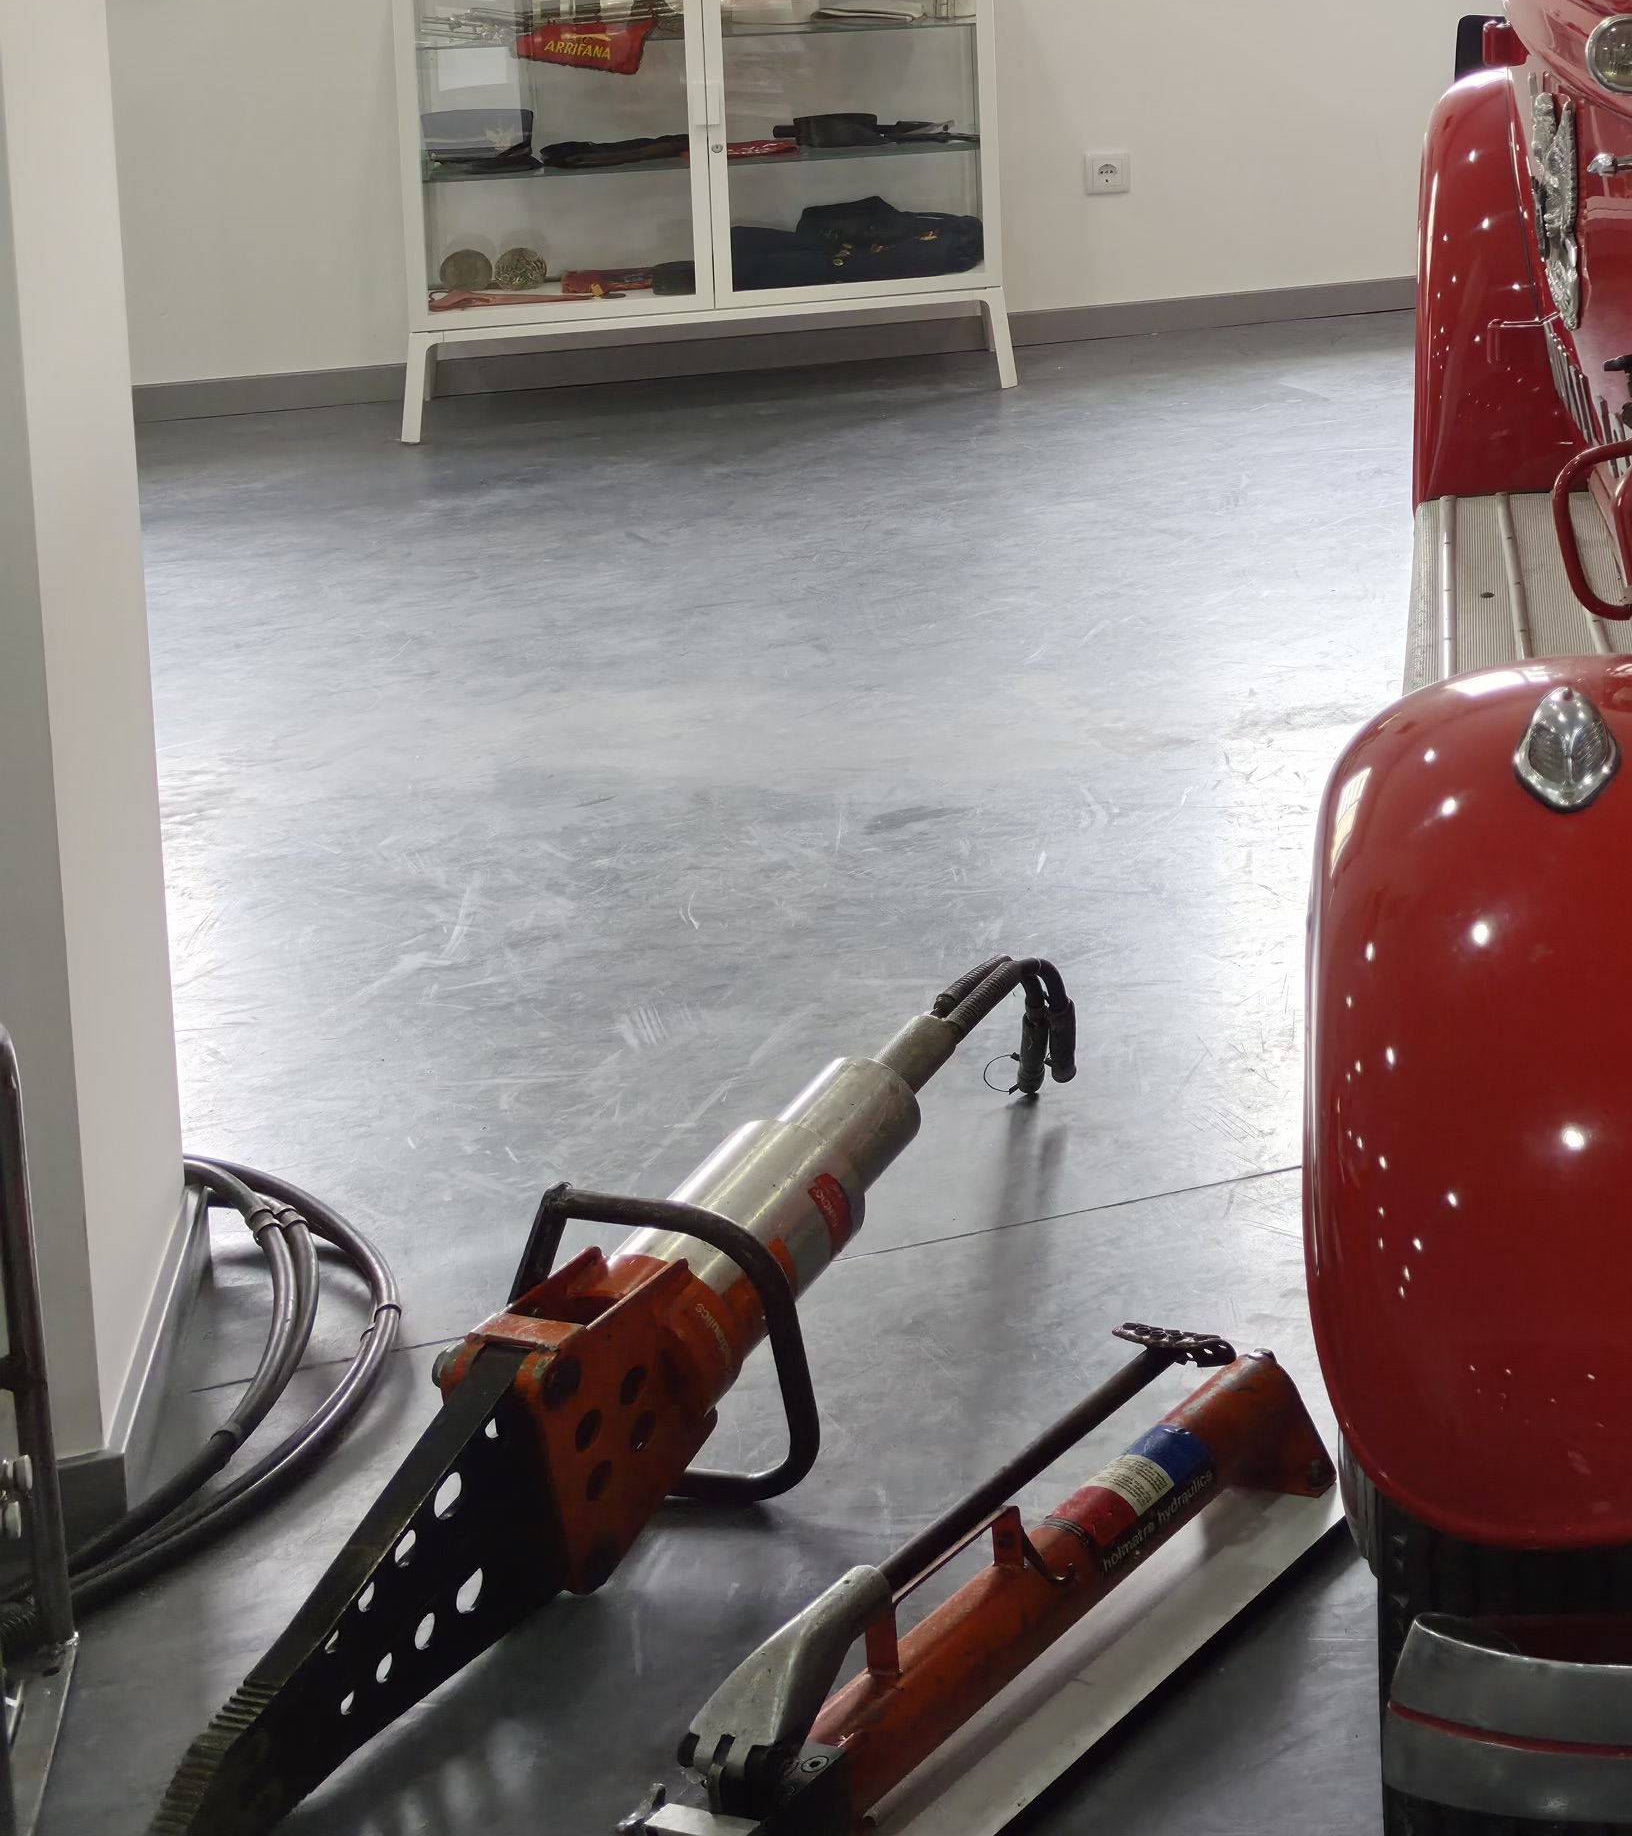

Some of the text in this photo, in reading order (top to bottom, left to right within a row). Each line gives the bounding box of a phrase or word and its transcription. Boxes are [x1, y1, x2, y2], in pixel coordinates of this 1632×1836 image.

[543, 40, 611, 60] ARRIFANA
[1101, 1521, 1156, 1573] holmatro
[1157, 1468, 1214, 1525] hydraulics
